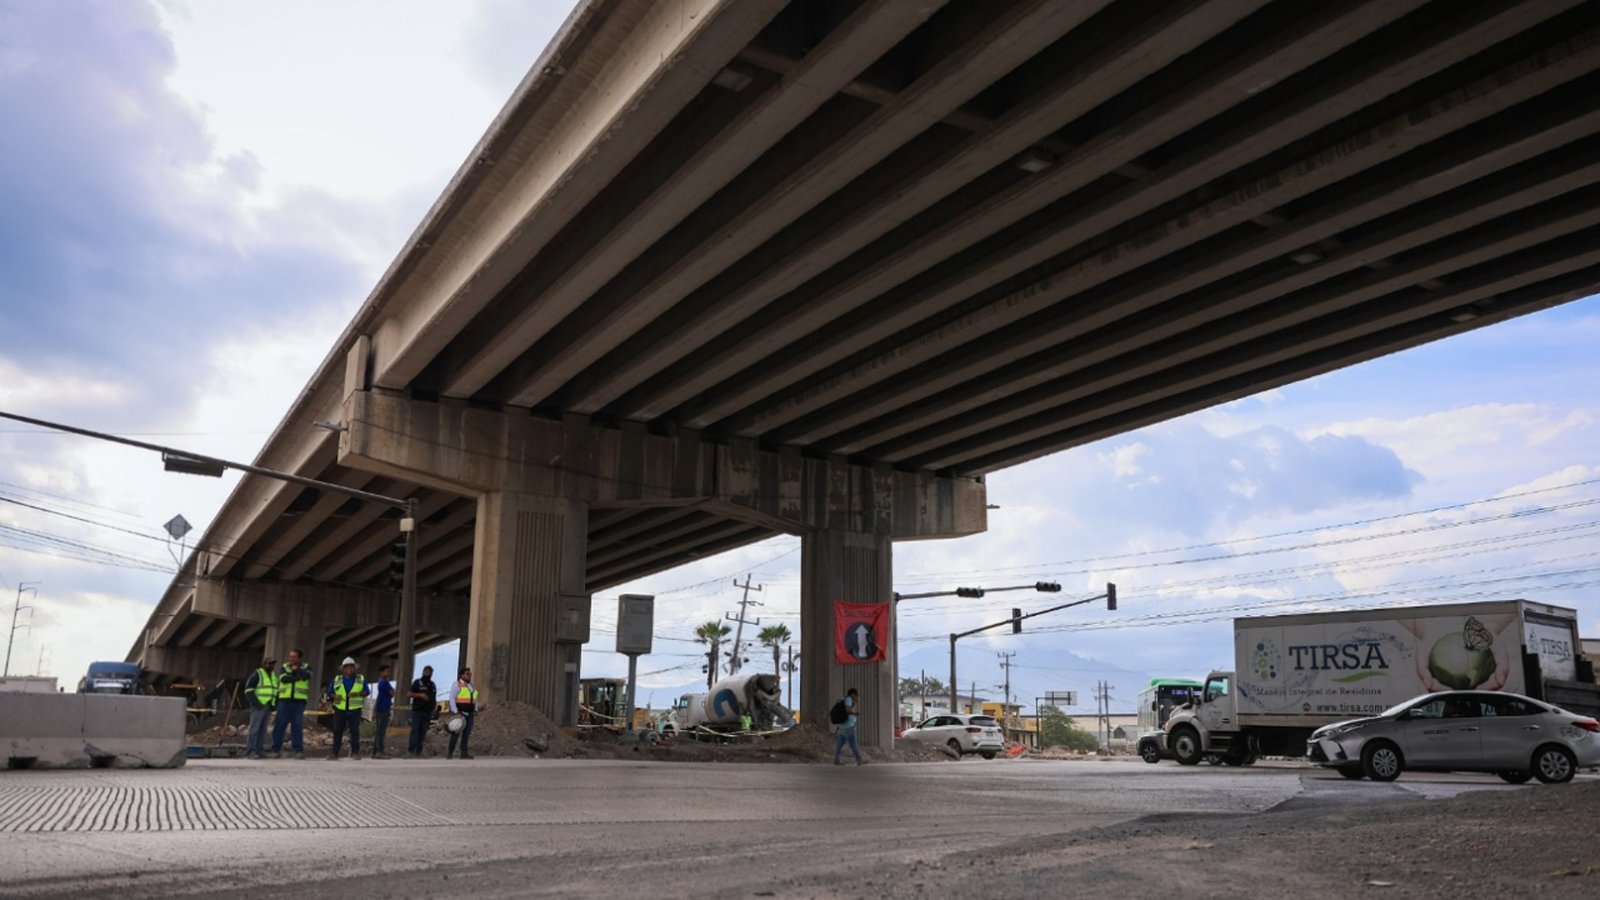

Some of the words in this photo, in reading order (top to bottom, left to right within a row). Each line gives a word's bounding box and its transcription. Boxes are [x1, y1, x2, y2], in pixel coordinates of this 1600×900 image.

[1288, 643, 1389, 671] TIRSA
[1541, 638, 1571, 657] TIRSA
[1256, 687, 1287, 698] Manejo
[1289, 687, 1323, 697] Integral
[1325, 687, 1337, 696] de
[1339, 687, 1383, 696] Residuos
